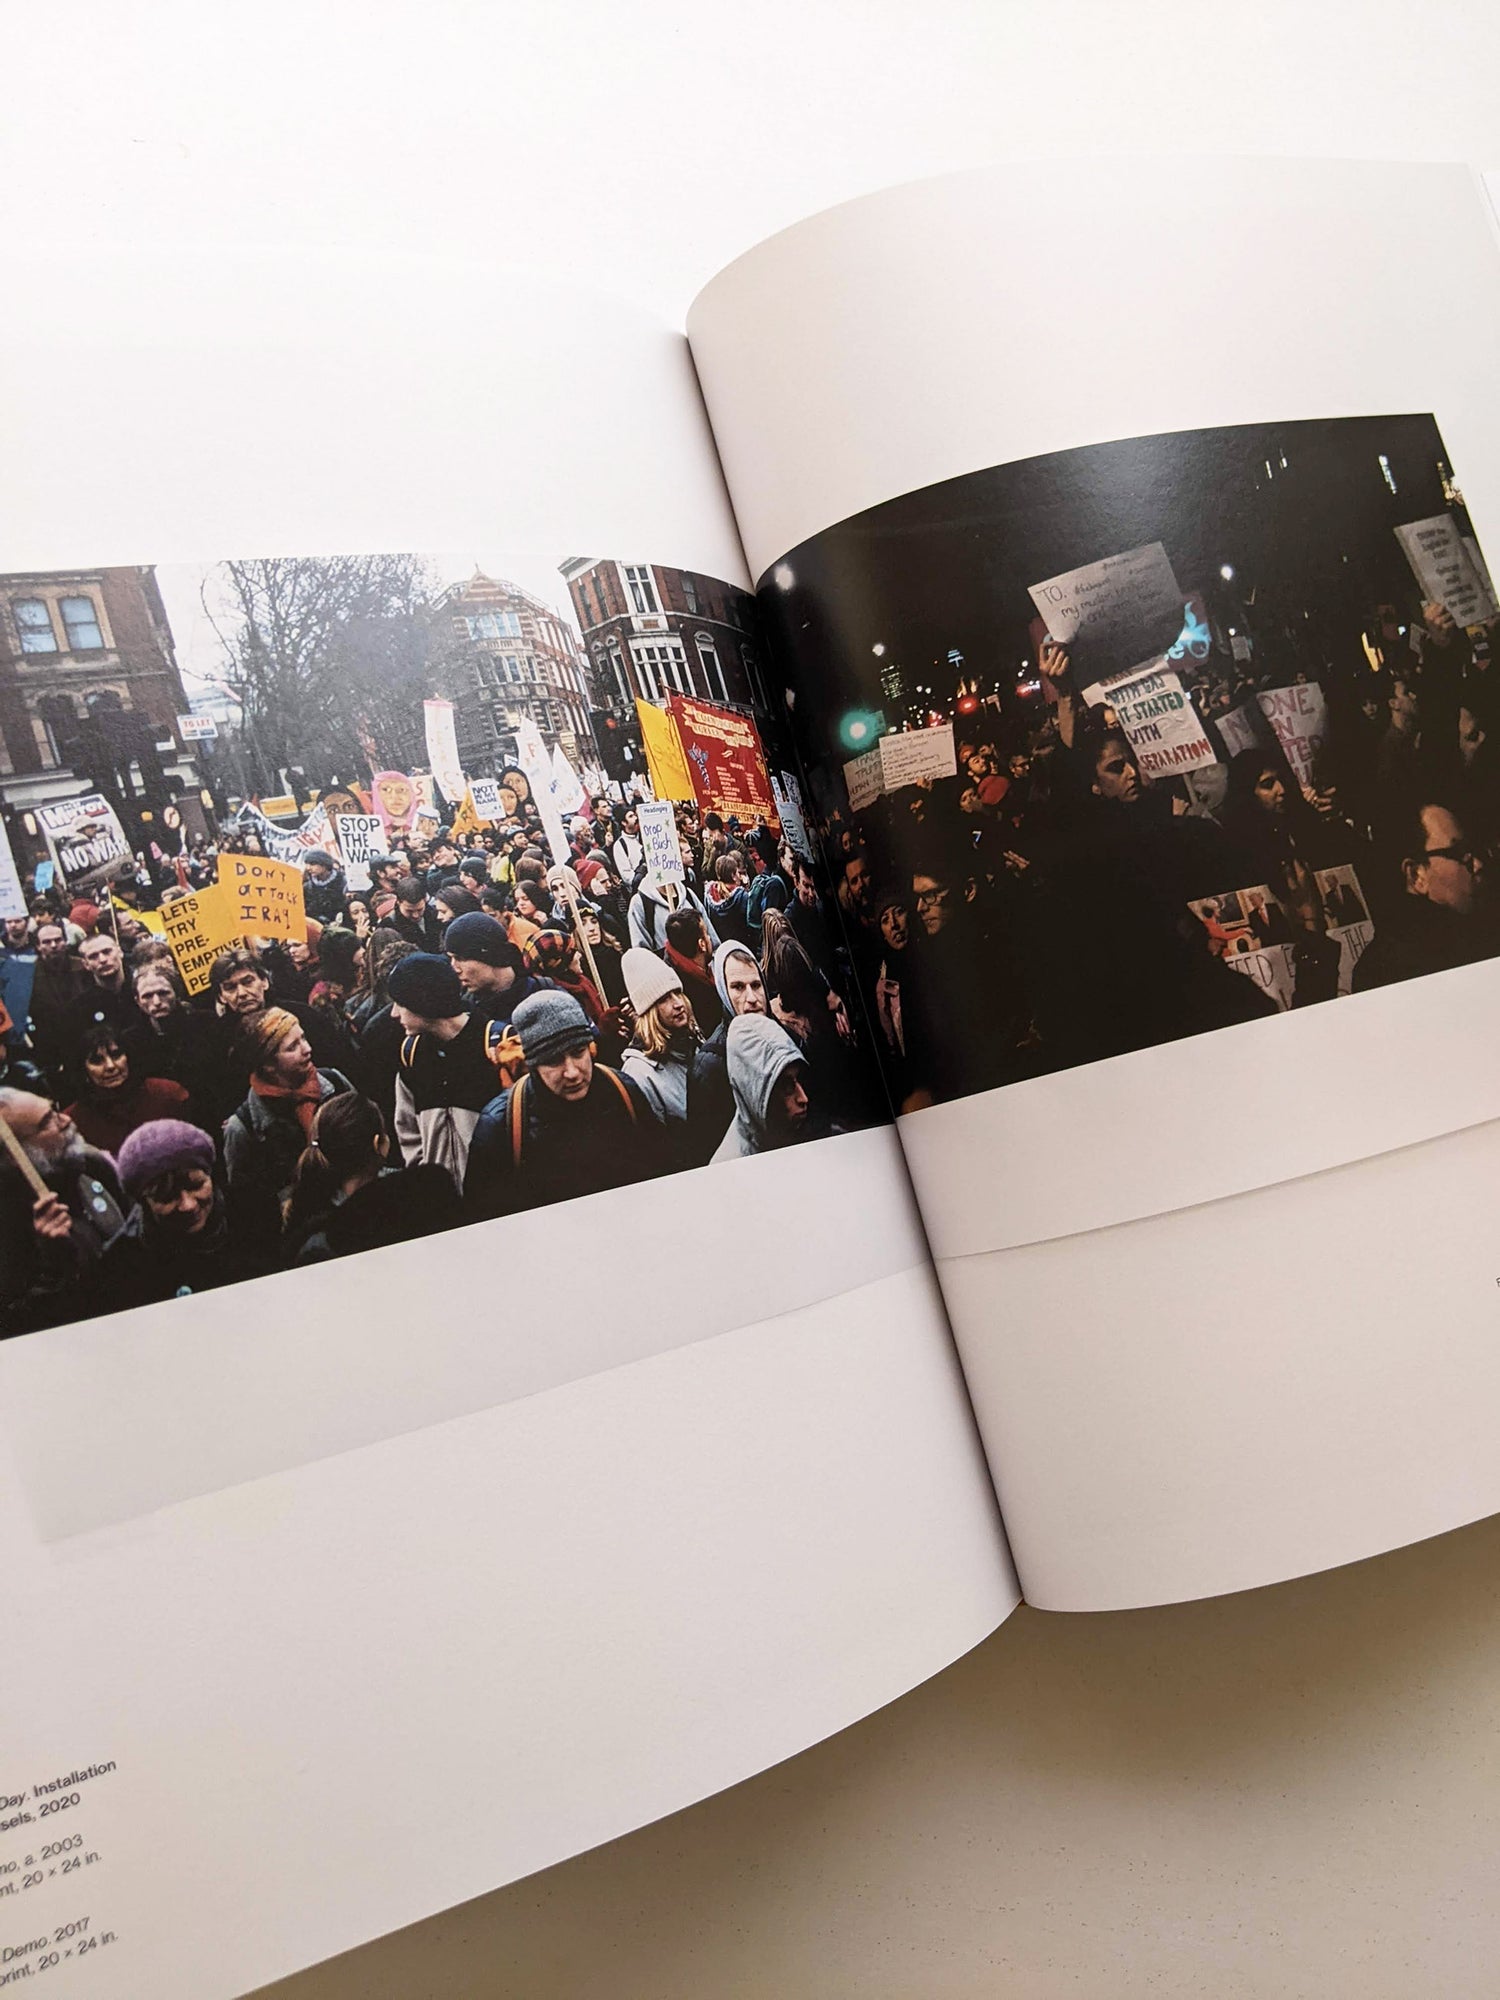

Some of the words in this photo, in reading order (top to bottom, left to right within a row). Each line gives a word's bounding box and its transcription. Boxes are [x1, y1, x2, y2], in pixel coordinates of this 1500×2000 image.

[1118, 706, 1131, 724] IT
[1134, 691, 1185, 719] STARTED
[1126, 723, 1162, 745] WITH
[1140, 738, 1212, 770] SEPARATION
[472, 785, 494, 794] NOT
[340, 817, 380, 832] STOP
[643, 823, 663, 838] Drop
[342, 833, 369, 848] THE
[652, 832, 673, 850] Bush
[60, 846, 90, 872] NO
[86, 837, 130, 863] WAR
[167, 918, 197, 939] TRY
[33, 1760, 117, 1797] Installation
[39, 1792, 81, 1817] 2020
[41, 1833, 83, 1860] 2003
[23, 1870, 44, 1889] 20
[62, 1856, 81, 1874] 24
[85, 1851, 102, 1865] in.
[54, 1916, 90, 1942] 2017
[38, 1951, 60, 1971] 20
[78, 1936, 97, 1956] 24
[101, 1931, 119, 1945] in.
